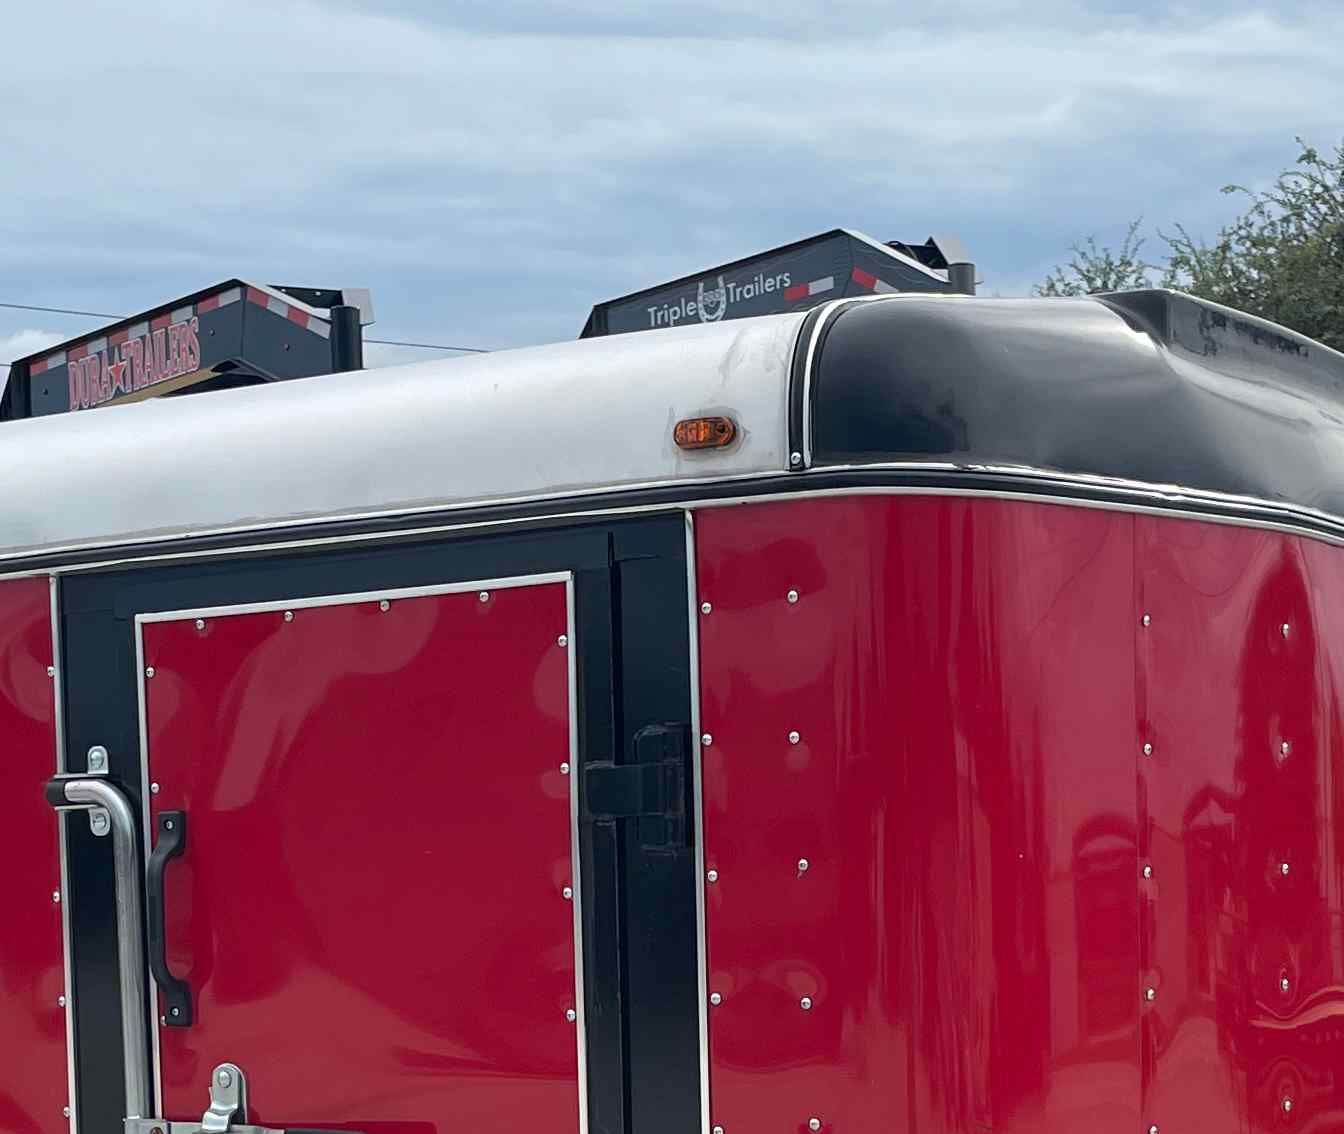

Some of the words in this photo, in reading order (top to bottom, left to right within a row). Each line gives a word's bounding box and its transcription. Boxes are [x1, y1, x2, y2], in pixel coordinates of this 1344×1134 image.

[648, 297, 698, 327] Triple
[727, 272, 792, 303] Trailers
[68, 352, 113, 412] DURA
[120, 316, 201, 393] TRAILERS
